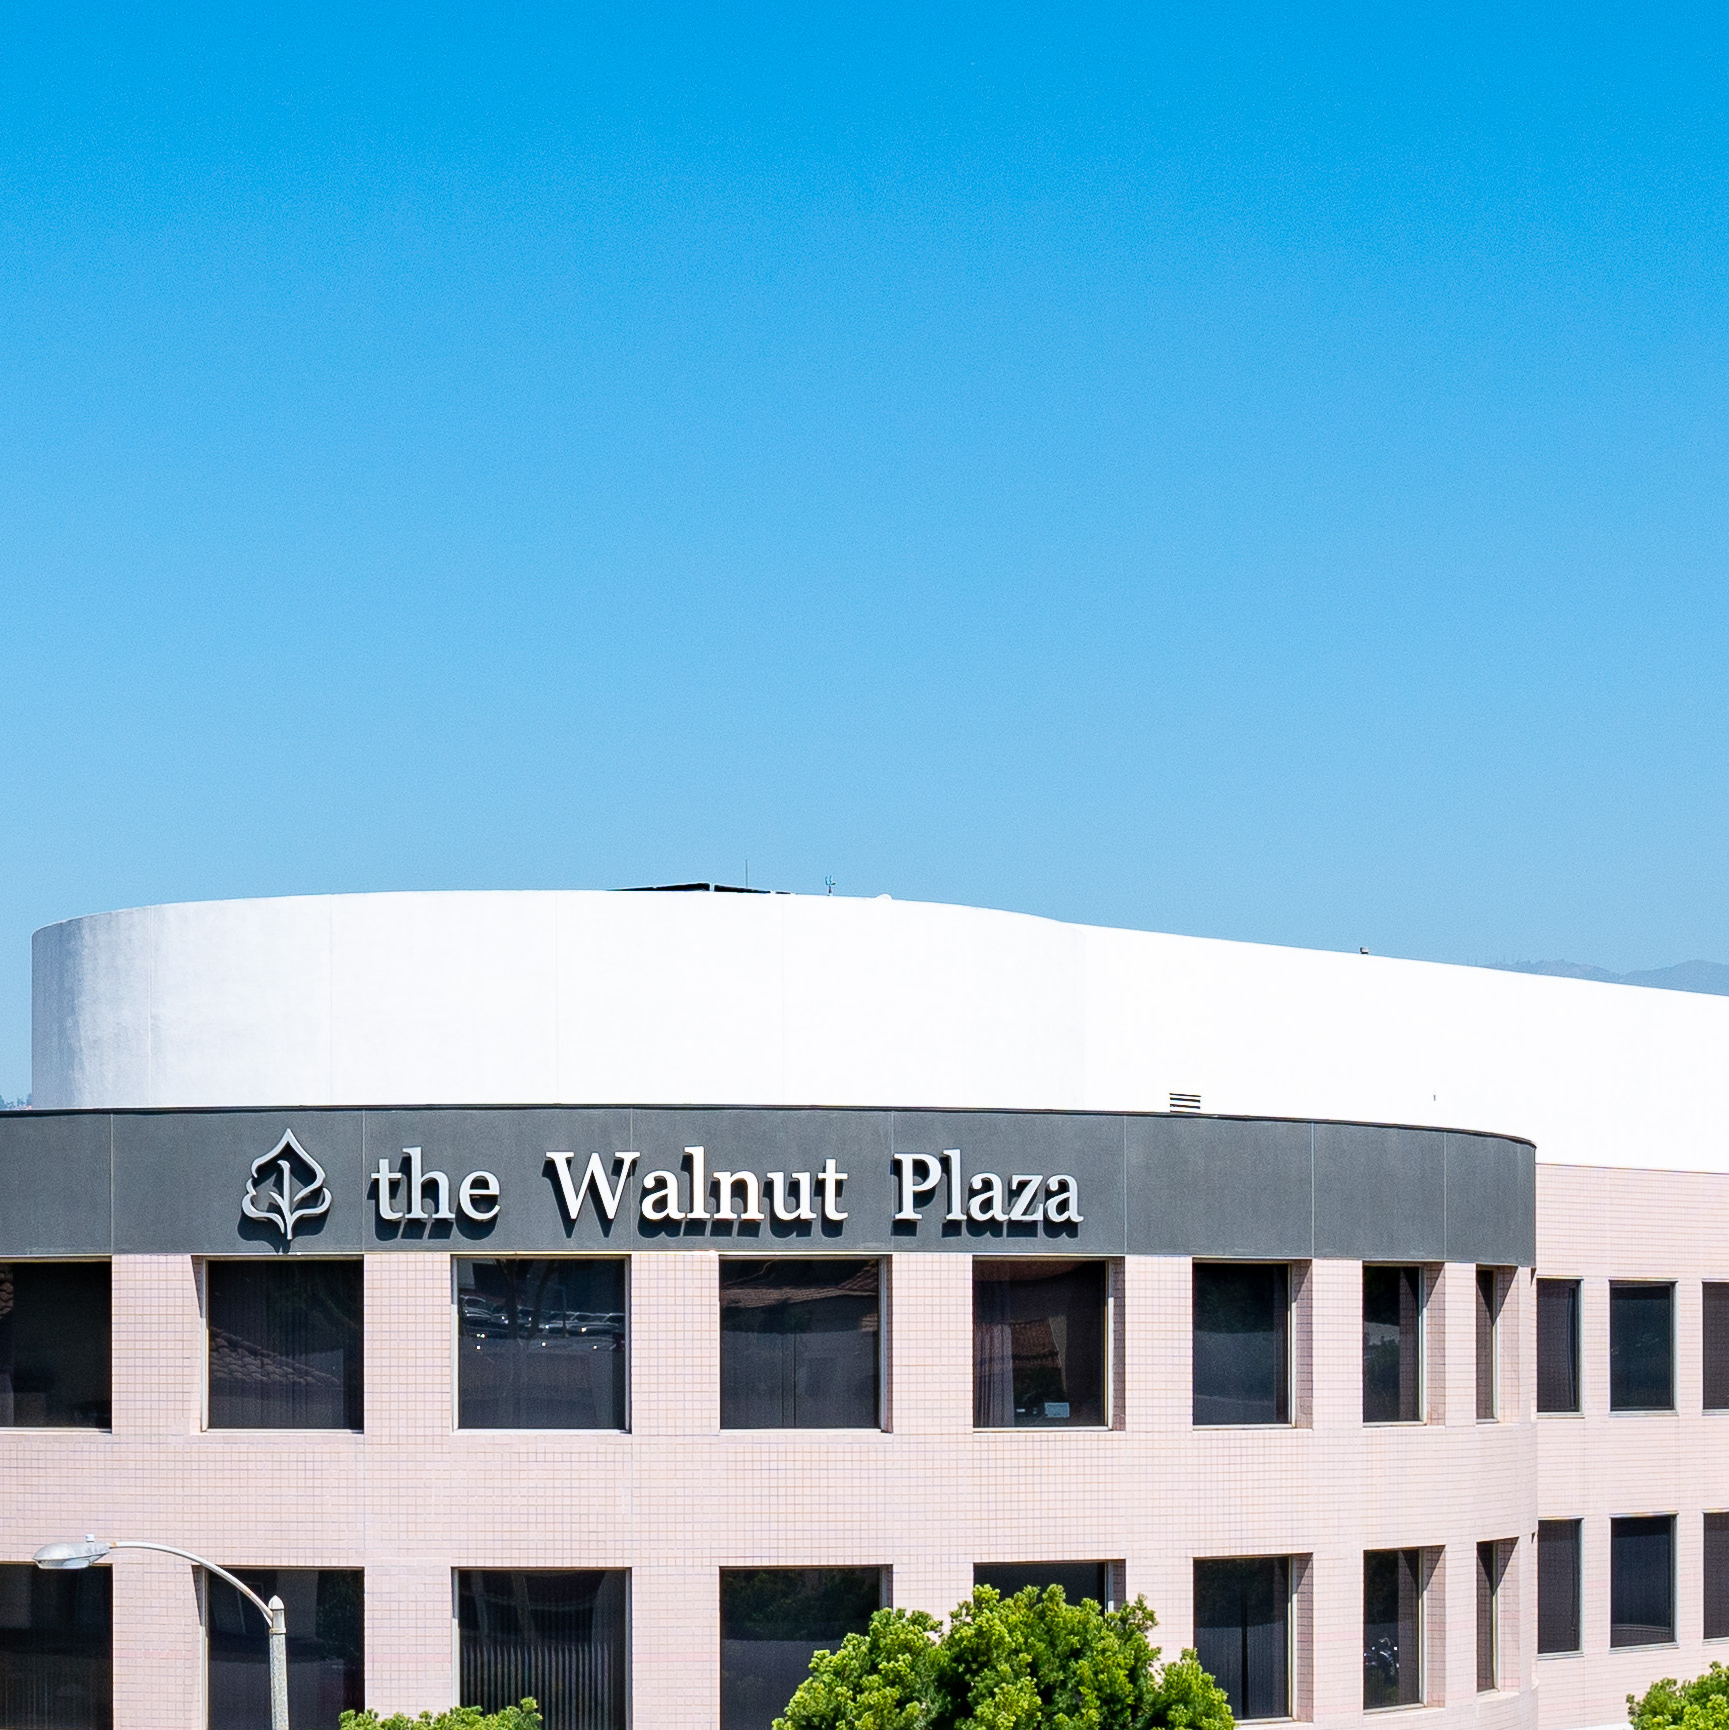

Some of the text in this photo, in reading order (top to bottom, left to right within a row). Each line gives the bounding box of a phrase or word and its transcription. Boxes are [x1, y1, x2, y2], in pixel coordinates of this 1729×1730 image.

[371, 1146, 1084, 1224] the Walnut Plaza
